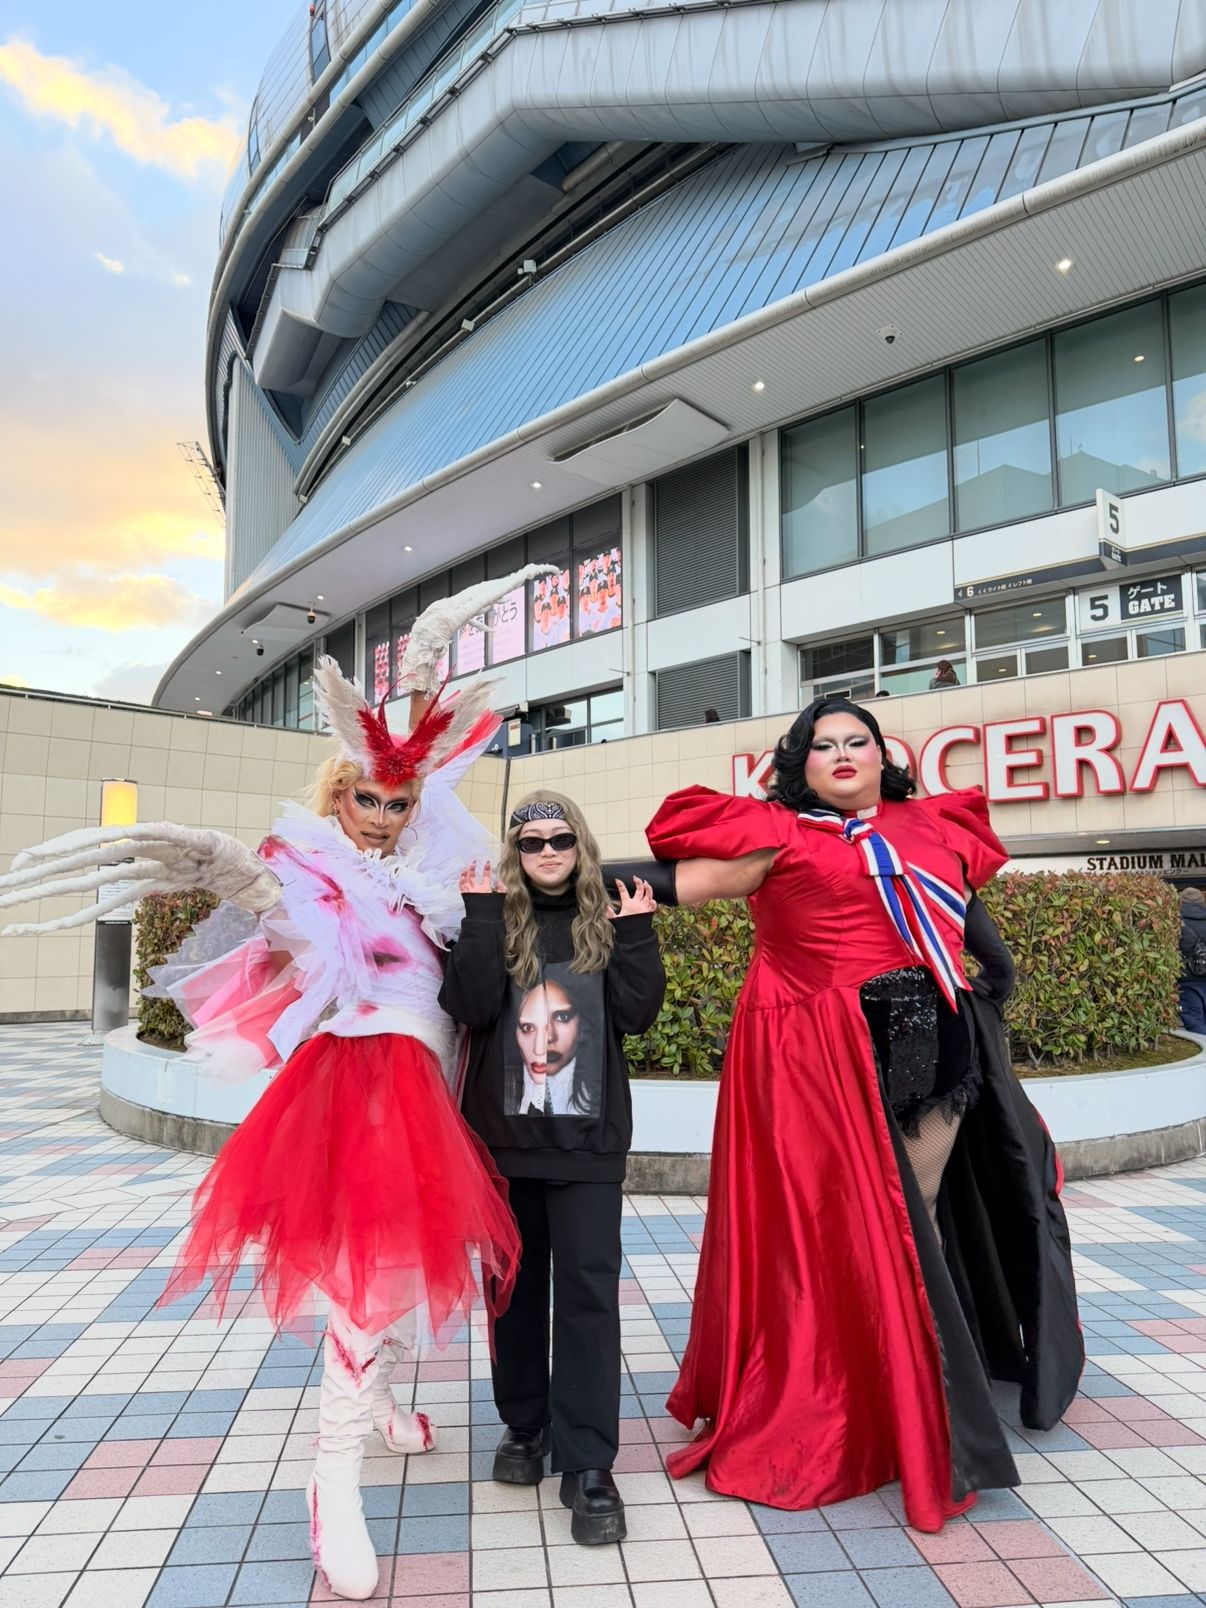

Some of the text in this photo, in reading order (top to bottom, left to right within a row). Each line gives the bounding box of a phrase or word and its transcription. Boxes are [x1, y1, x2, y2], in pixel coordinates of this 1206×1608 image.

[1108, 502, 1120, 535] 5
[966, 586, 975, 597] 6
[1128, 582, 1167, 599] ゲート
[1089, 594, 1109, 622] 5
[1128, 594, 1175, 615] GATE
[732, 699, 1206, 803] KCERA
[1087, 855, 1164, 870] STADIUM
